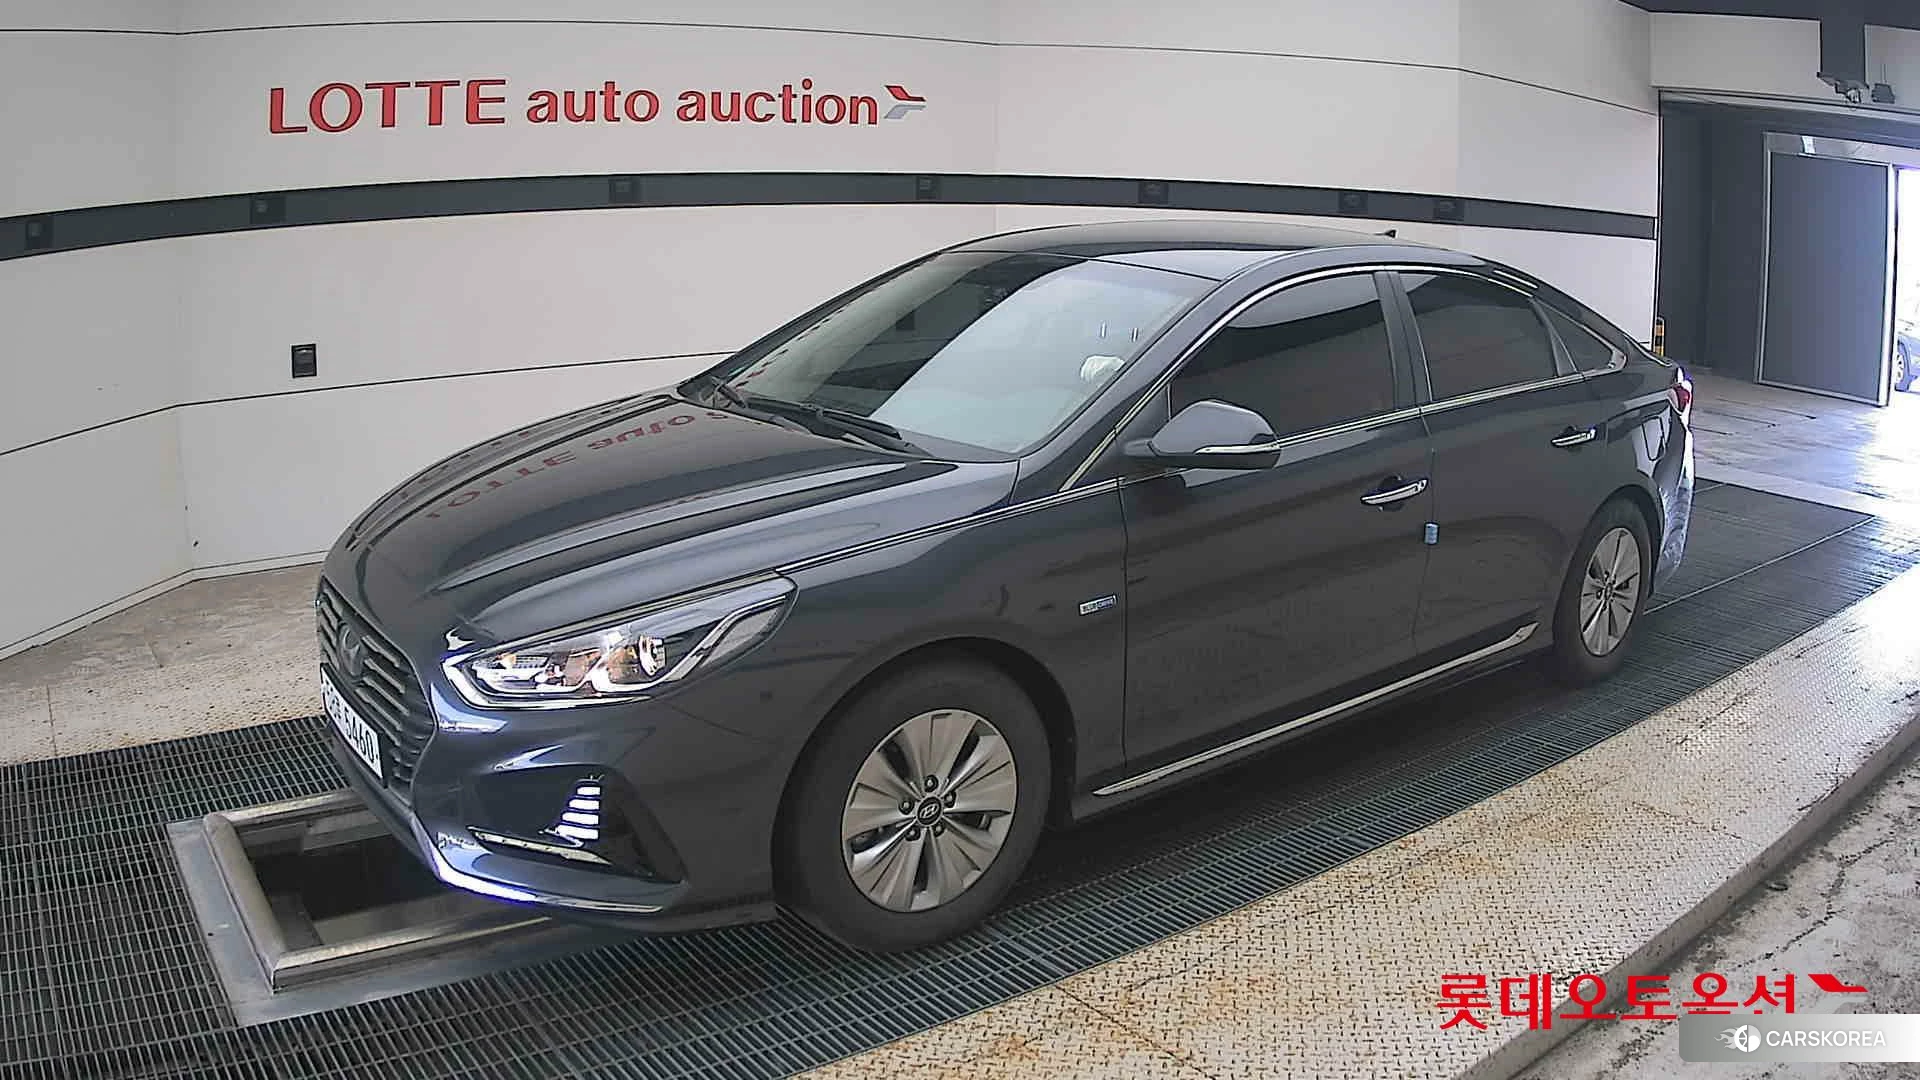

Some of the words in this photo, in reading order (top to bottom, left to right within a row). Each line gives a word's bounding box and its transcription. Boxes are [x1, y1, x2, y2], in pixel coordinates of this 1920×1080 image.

[269, 79, 506, 134] LOTTE
[526, 80, 659, 124] auto
[676, 79, 879, 125] auction
